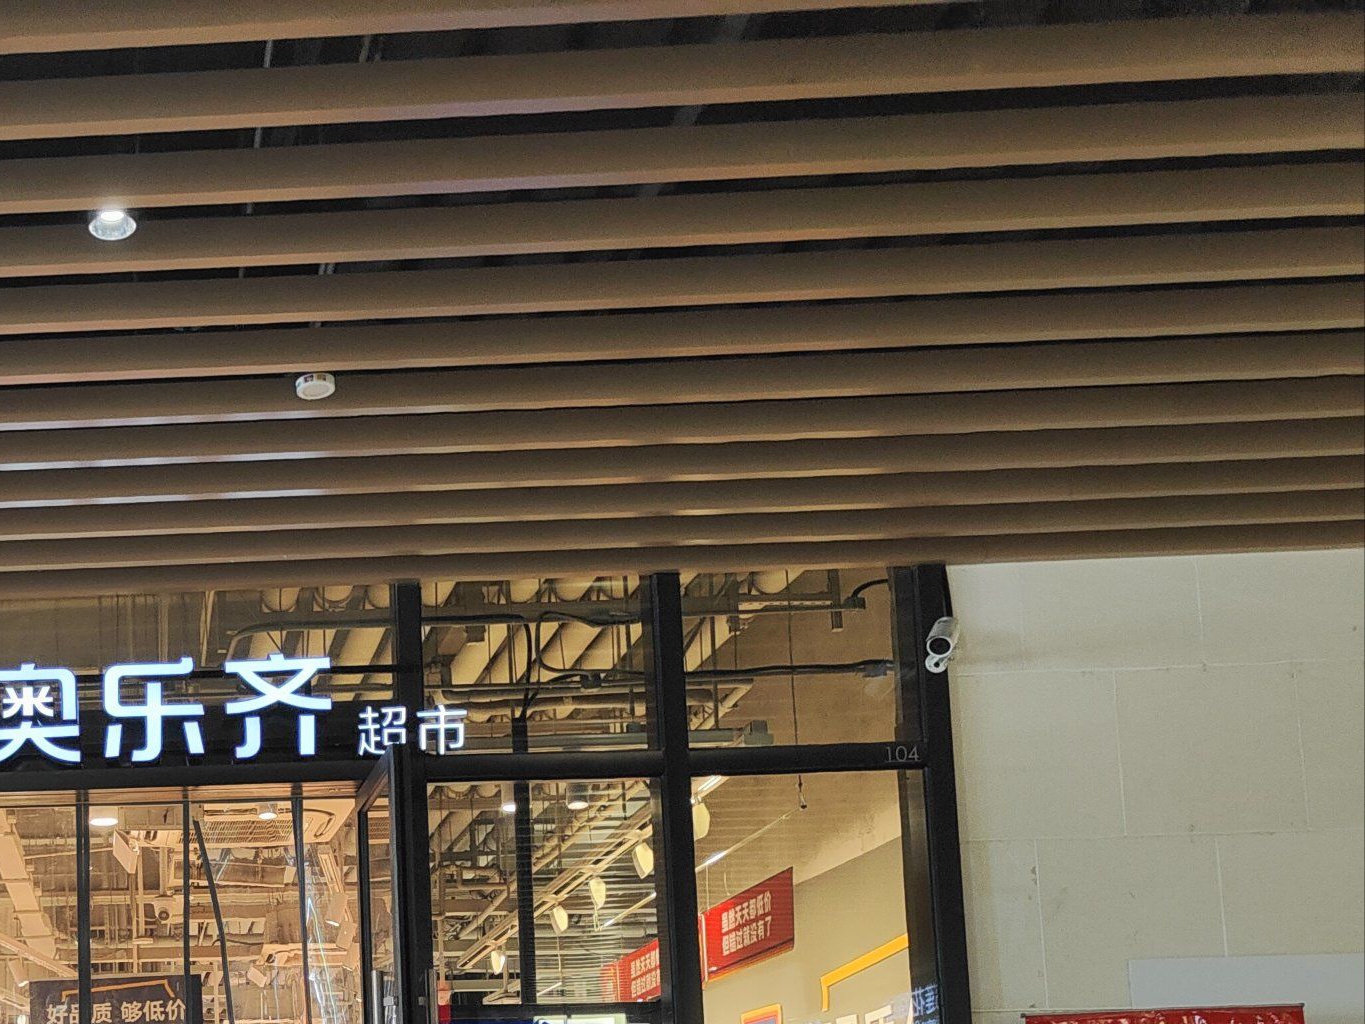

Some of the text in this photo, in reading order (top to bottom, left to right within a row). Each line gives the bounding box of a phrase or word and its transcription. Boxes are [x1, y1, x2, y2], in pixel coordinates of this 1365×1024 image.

[358, 701, 469, 756] 超市
[885, 745, 920, 762] 104
[721, 890, 772, 934] 虽然天天都低价
[721, 915, 772, 957] 但错过就没有了
[120, 998, 186, 1023] 够低价
